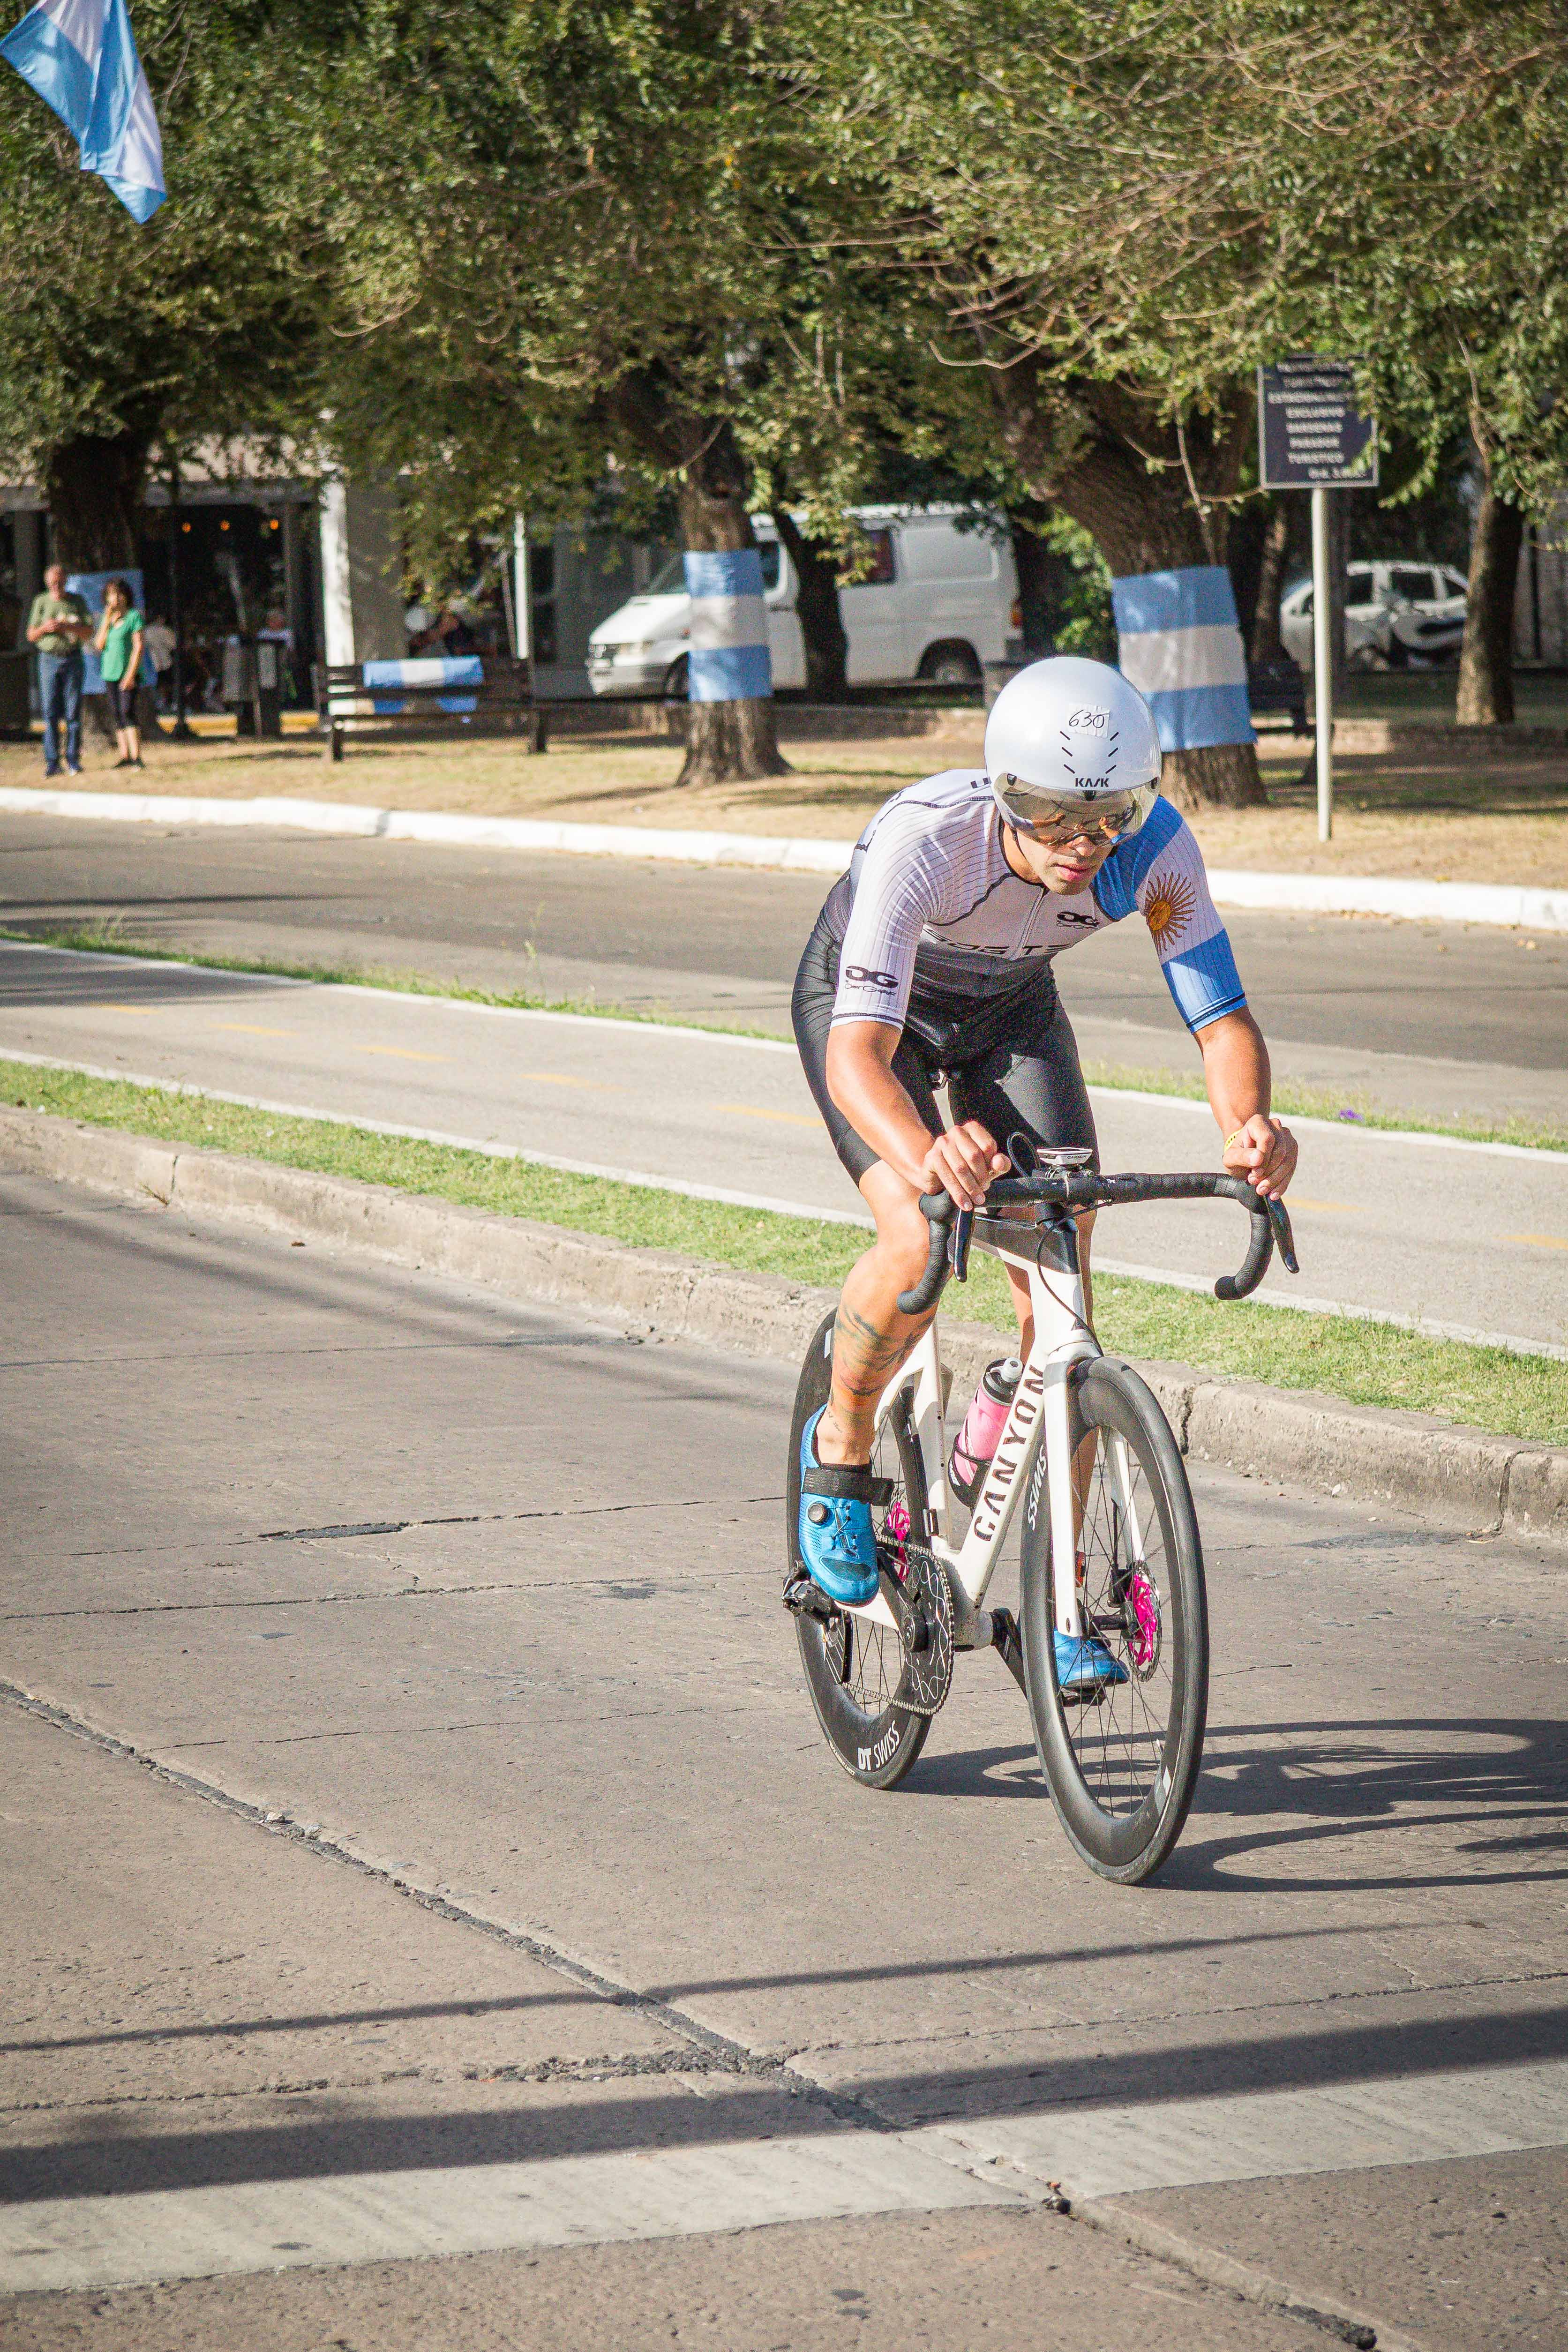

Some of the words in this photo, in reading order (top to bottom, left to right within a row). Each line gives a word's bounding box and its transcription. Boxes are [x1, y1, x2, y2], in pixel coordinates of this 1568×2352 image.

[1068, 709, 1105, 729] 630
[1075, 778, 1109, 787] KASK
[845, 966, 899, 989] OG
[974, 1364, 1043, 1542] CANYON
[858, 1747, 871, 1771] DT
[873, 1719, 900, 1768] SWISS
